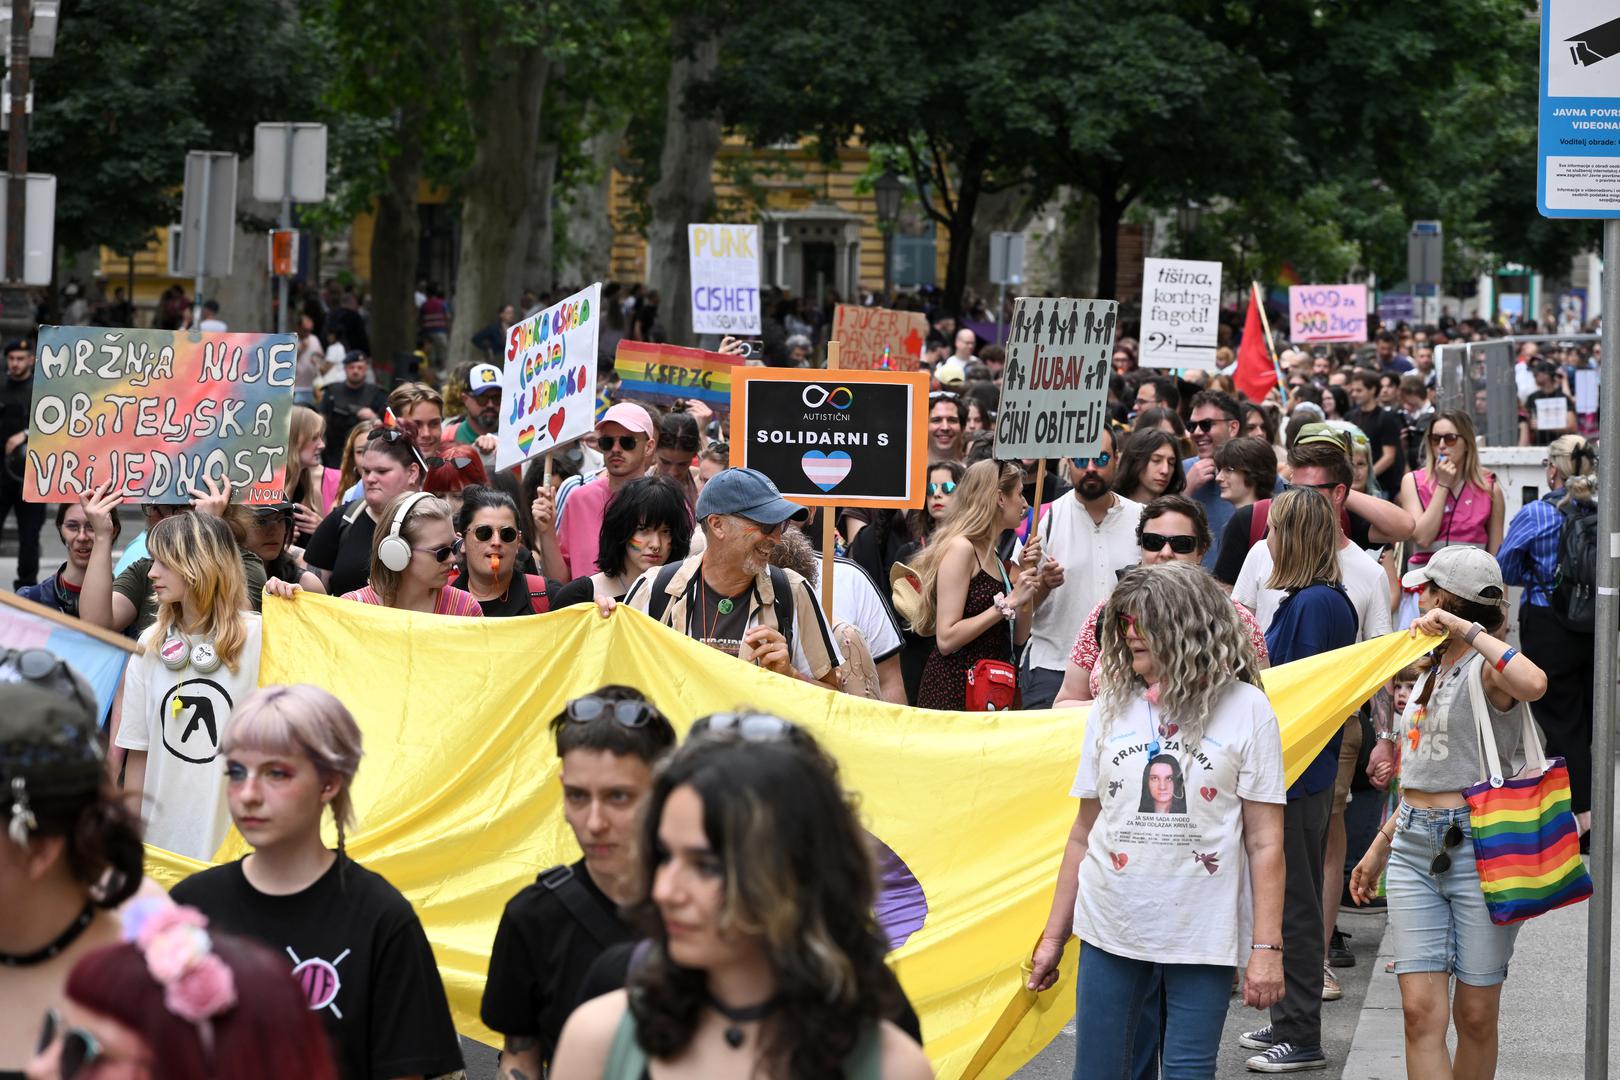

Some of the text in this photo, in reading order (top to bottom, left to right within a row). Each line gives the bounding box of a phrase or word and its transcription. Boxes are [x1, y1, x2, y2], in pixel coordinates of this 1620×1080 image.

[1553, 108, 1587, 117] JAVNA
[1572, 121, 1620, 130] VIDEONA
[1560, 137, 1587, 147] Voditelj
[694, 227, 754, 258] PUNK
[1158, 267, 1213, 288] tišina,
[694, 286, 757, 313] CISHET
[1151, 305, 1209, 327] fagoti!
[198, 342, 295, 386] NIJE
[803, 412, 850, 421] AUTISTIČNI
[757, 429, 889, 446] SOLIDARNI S
[1164, 741, 1180, 751] ZA
